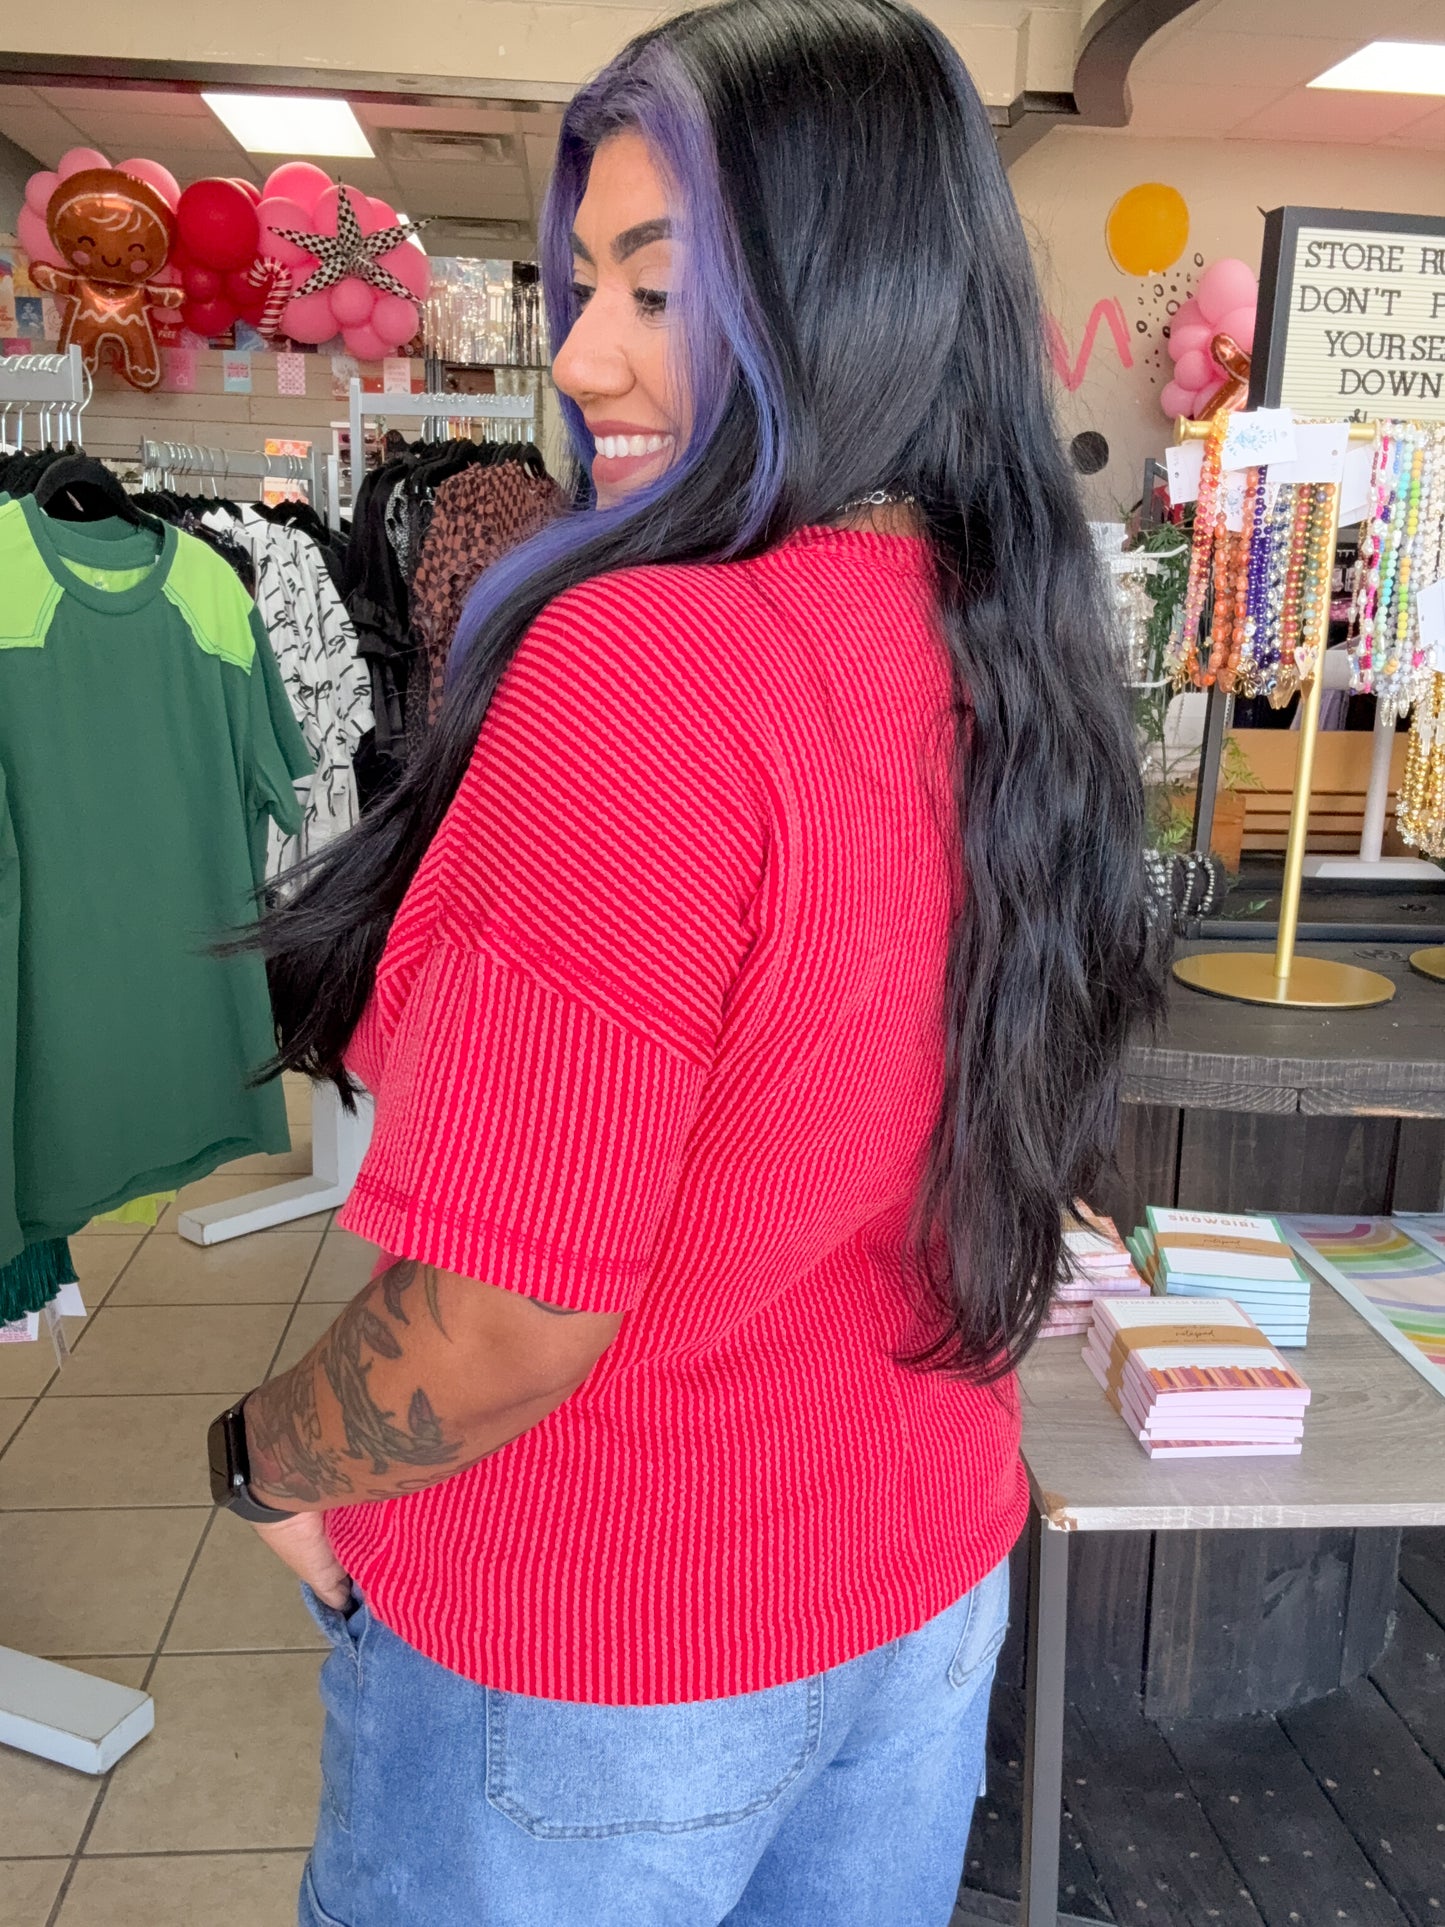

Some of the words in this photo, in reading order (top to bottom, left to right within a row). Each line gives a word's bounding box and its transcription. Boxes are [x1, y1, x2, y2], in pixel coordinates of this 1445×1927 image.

[1304, 240, 1404, 273] STORE
[1297, 285, 1402, 316] DON'T
[1324, 330, 1445, 362] YOURSE
[1338, 368, 1444, 399] DOWN
[1167, 1214, 1261, 1229] SHOWGIRL
